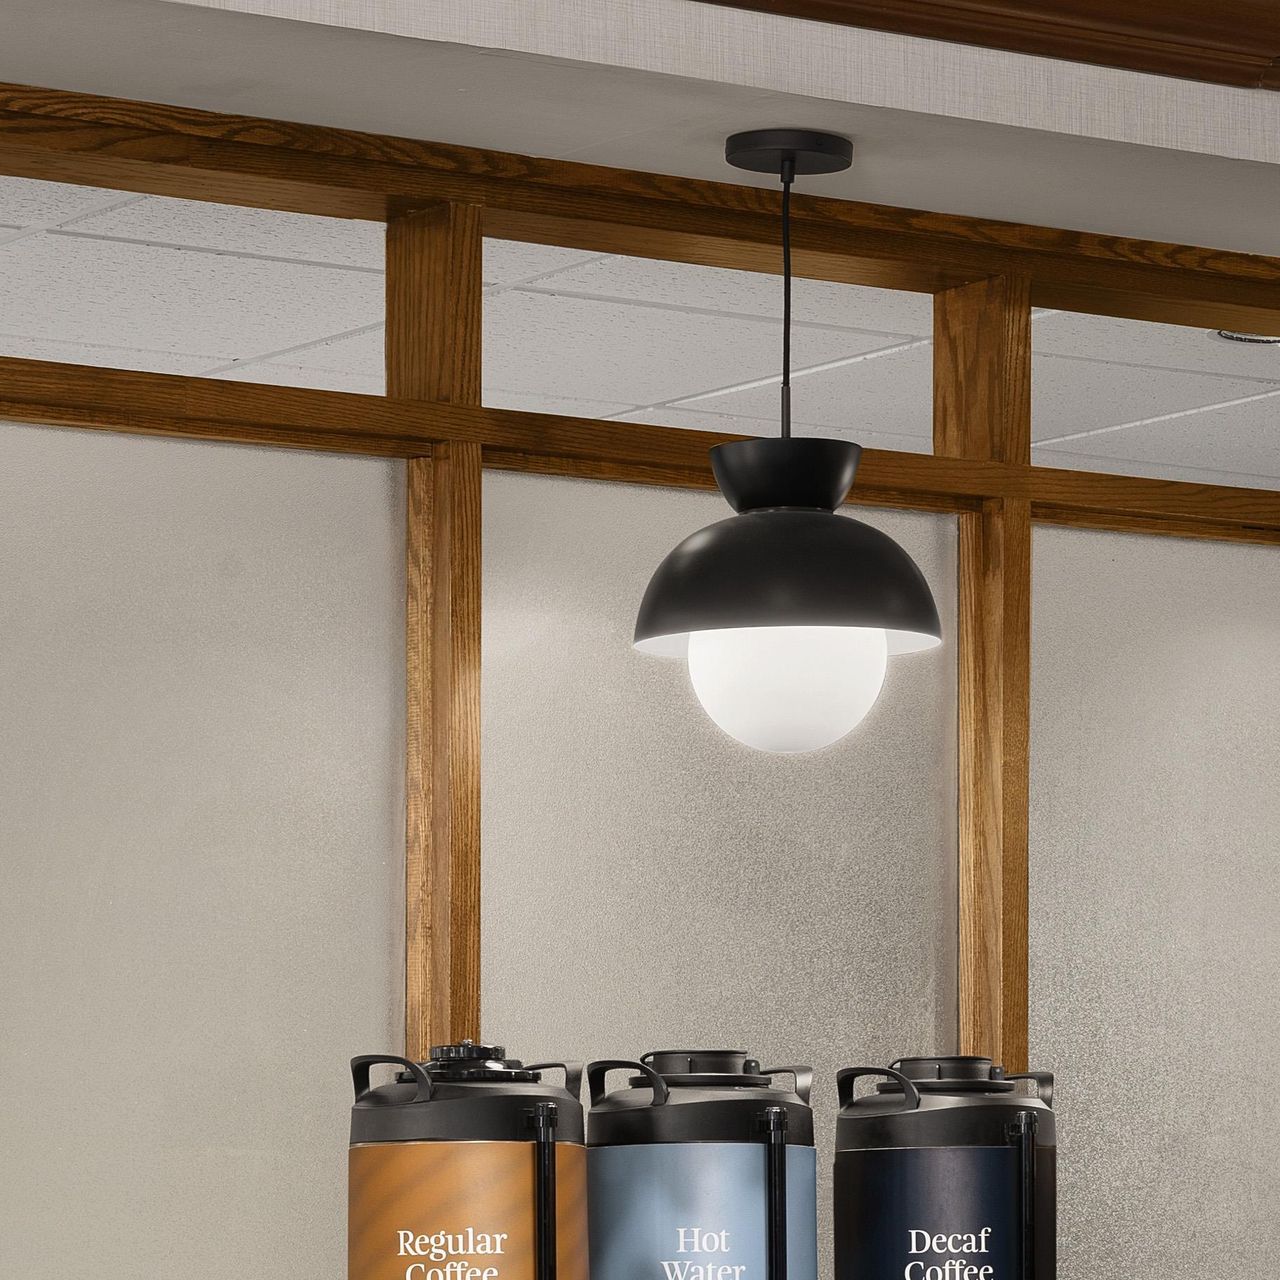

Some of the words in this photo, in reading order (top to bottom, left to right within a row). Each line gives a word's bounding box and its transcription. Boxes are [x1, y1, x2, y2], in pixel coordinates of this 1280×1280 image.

[397, 1228, 508, 1261] Regular
[676, 1228, 730, 1253] Hot
[908, 1227, 992, 1254] Decaf
